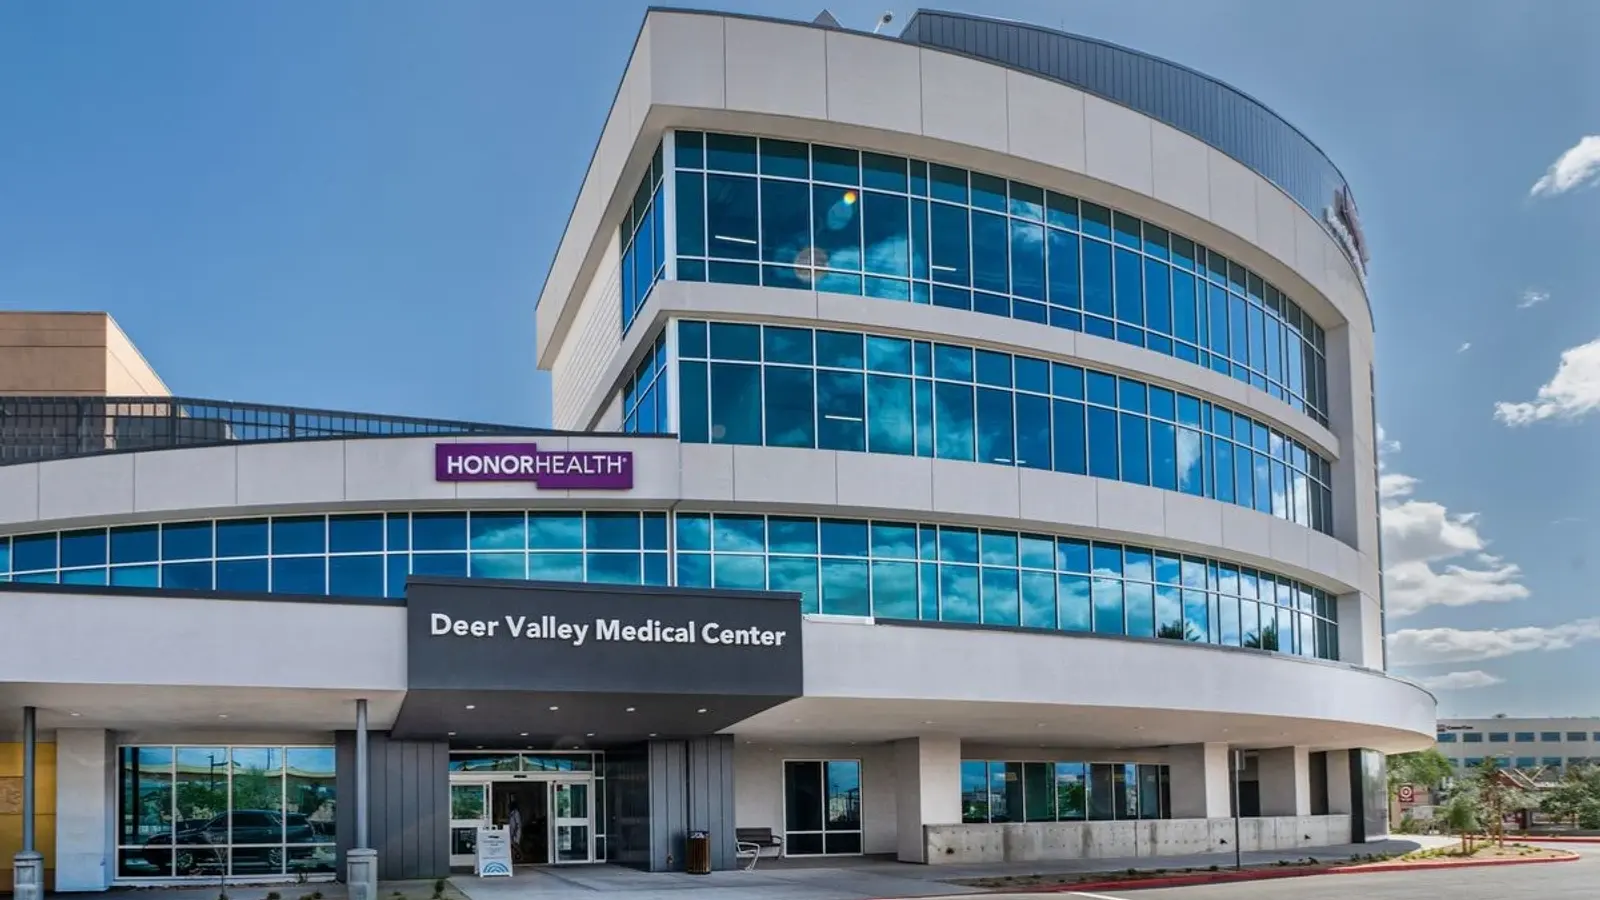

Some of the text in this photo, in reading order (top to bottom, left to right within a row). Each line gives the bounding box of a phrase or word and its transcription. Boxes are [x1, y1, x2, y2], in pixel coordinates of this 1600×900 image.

[430, 612, 787, 646] Deer Valley Medical Center
